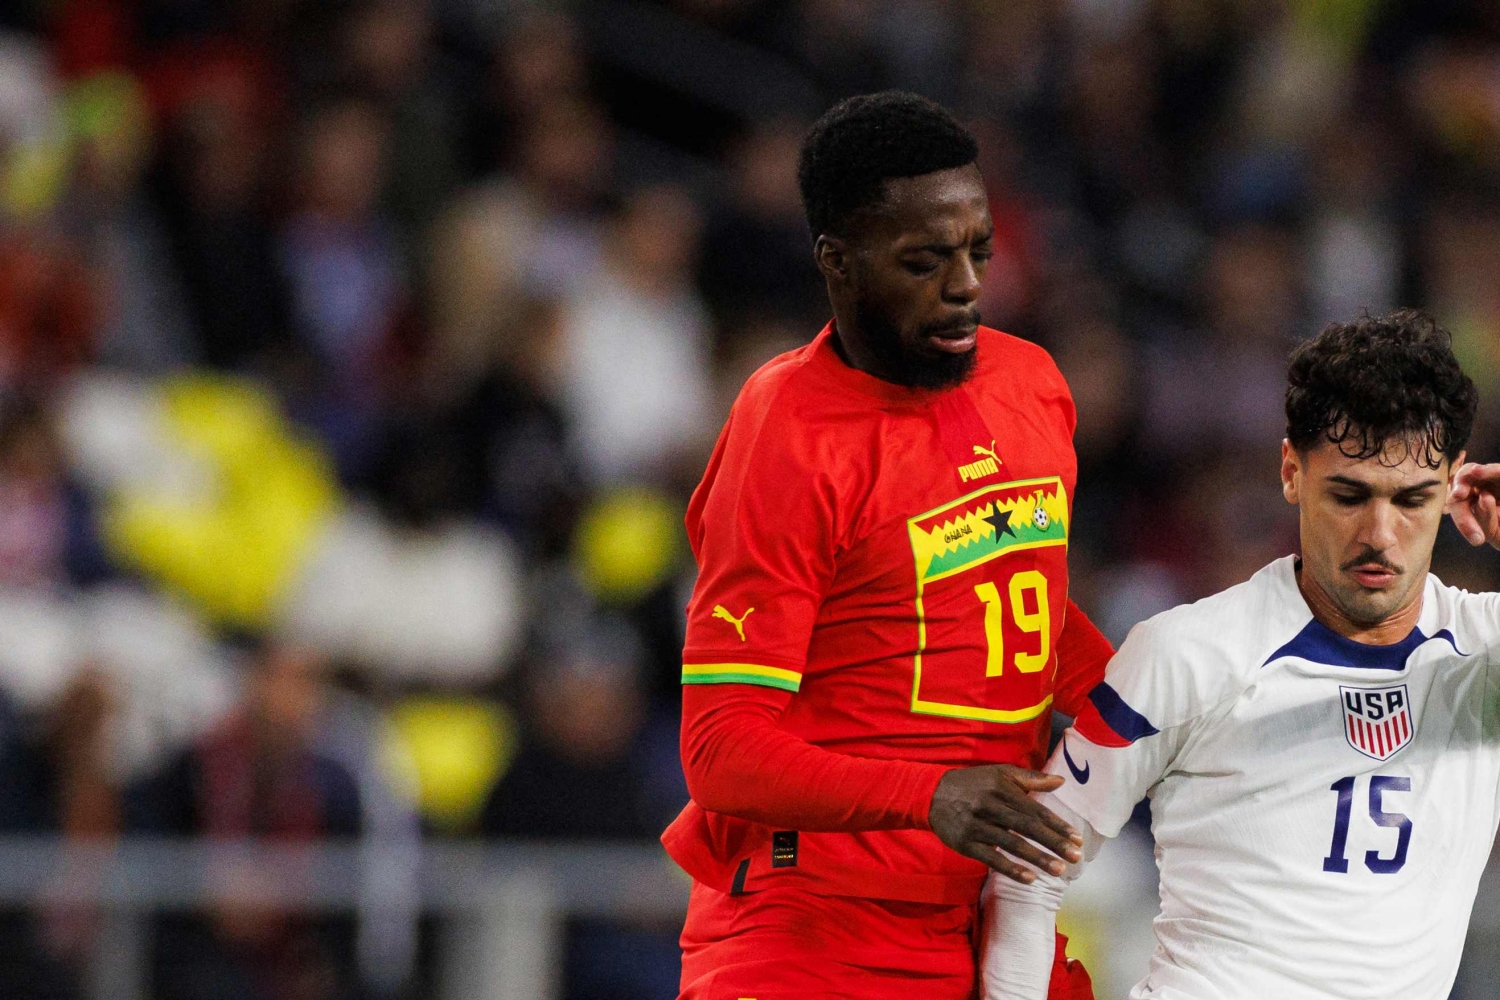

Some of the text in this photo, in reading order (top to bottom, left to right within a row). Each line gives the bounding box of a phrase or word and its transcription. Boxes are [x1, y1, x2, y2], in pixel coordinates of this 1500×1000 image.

[958, 457, 999, 482] PUMA
[944, 524, 973, 543] GHANA
[974, 570, 1051, 678] 19
[1345, 690, 1404, 720] USA
[1323, 775, 1413, 874] 15
